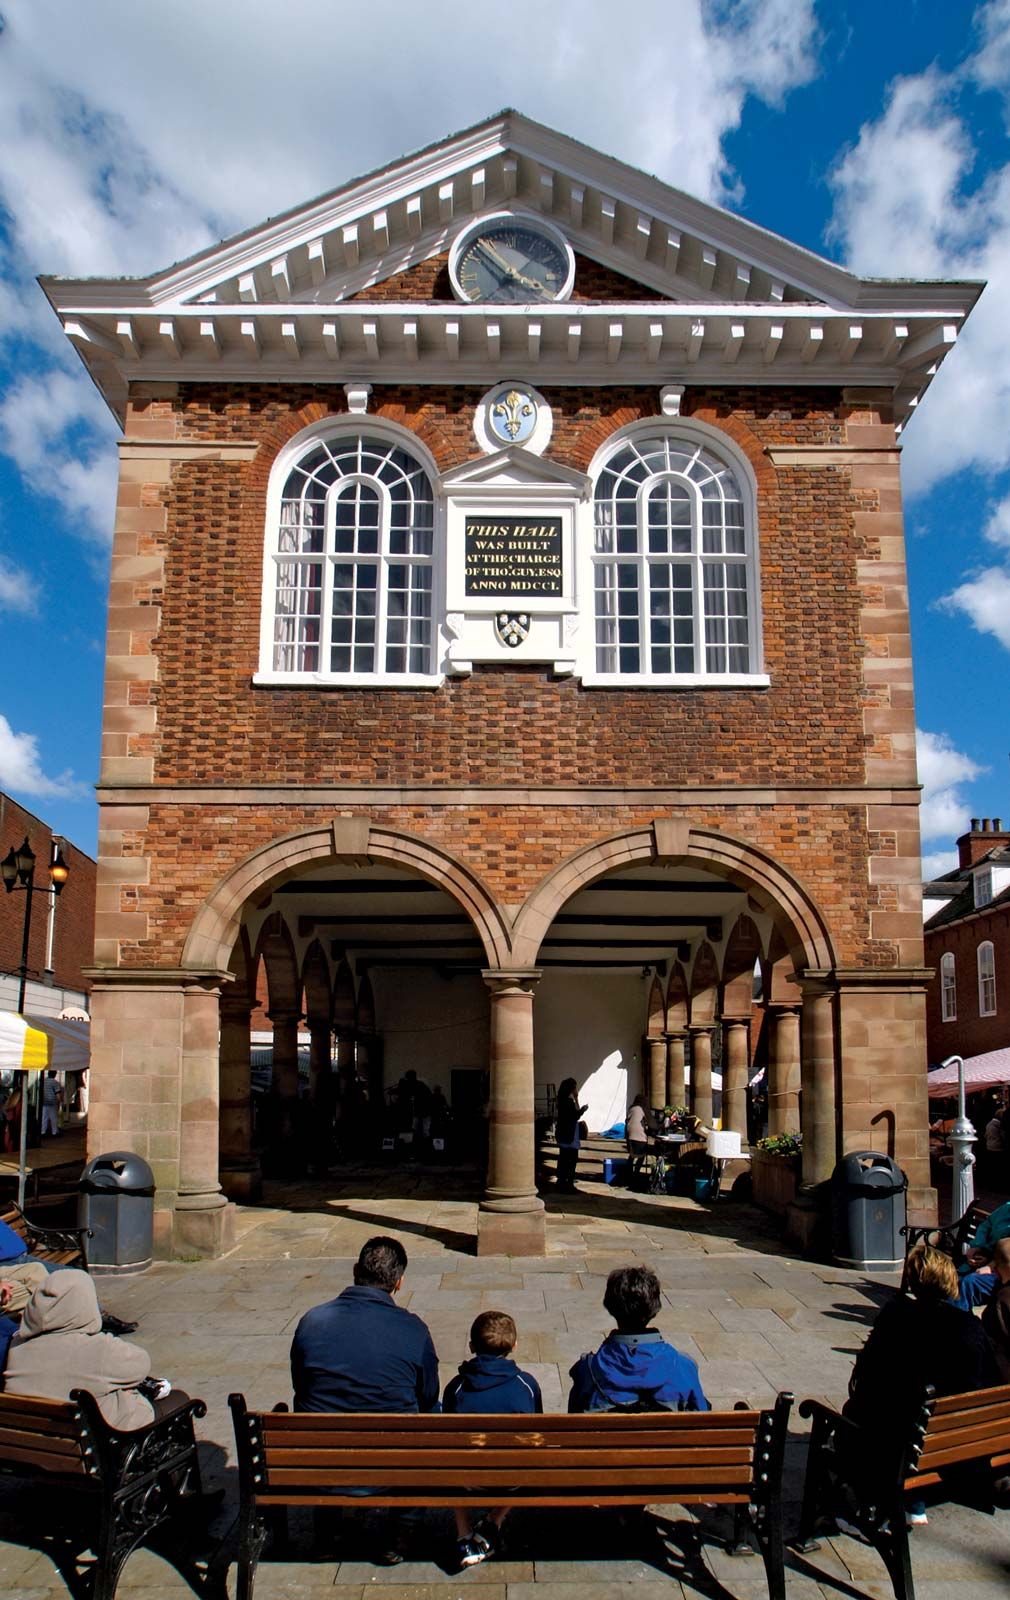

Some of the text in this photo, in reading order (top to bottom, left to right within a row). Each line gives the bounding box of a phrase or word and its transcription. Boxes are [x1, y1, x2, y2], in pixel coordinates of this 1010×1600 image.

[466, 525, 558, 537] THIS HALL
[475, 541, 551, 550] WAS BUILT
[466, 554, 560, 563] AT THE CHARGE
[465, 567, 480, 576] OF
[470, 581, 507, 590] ANNO
